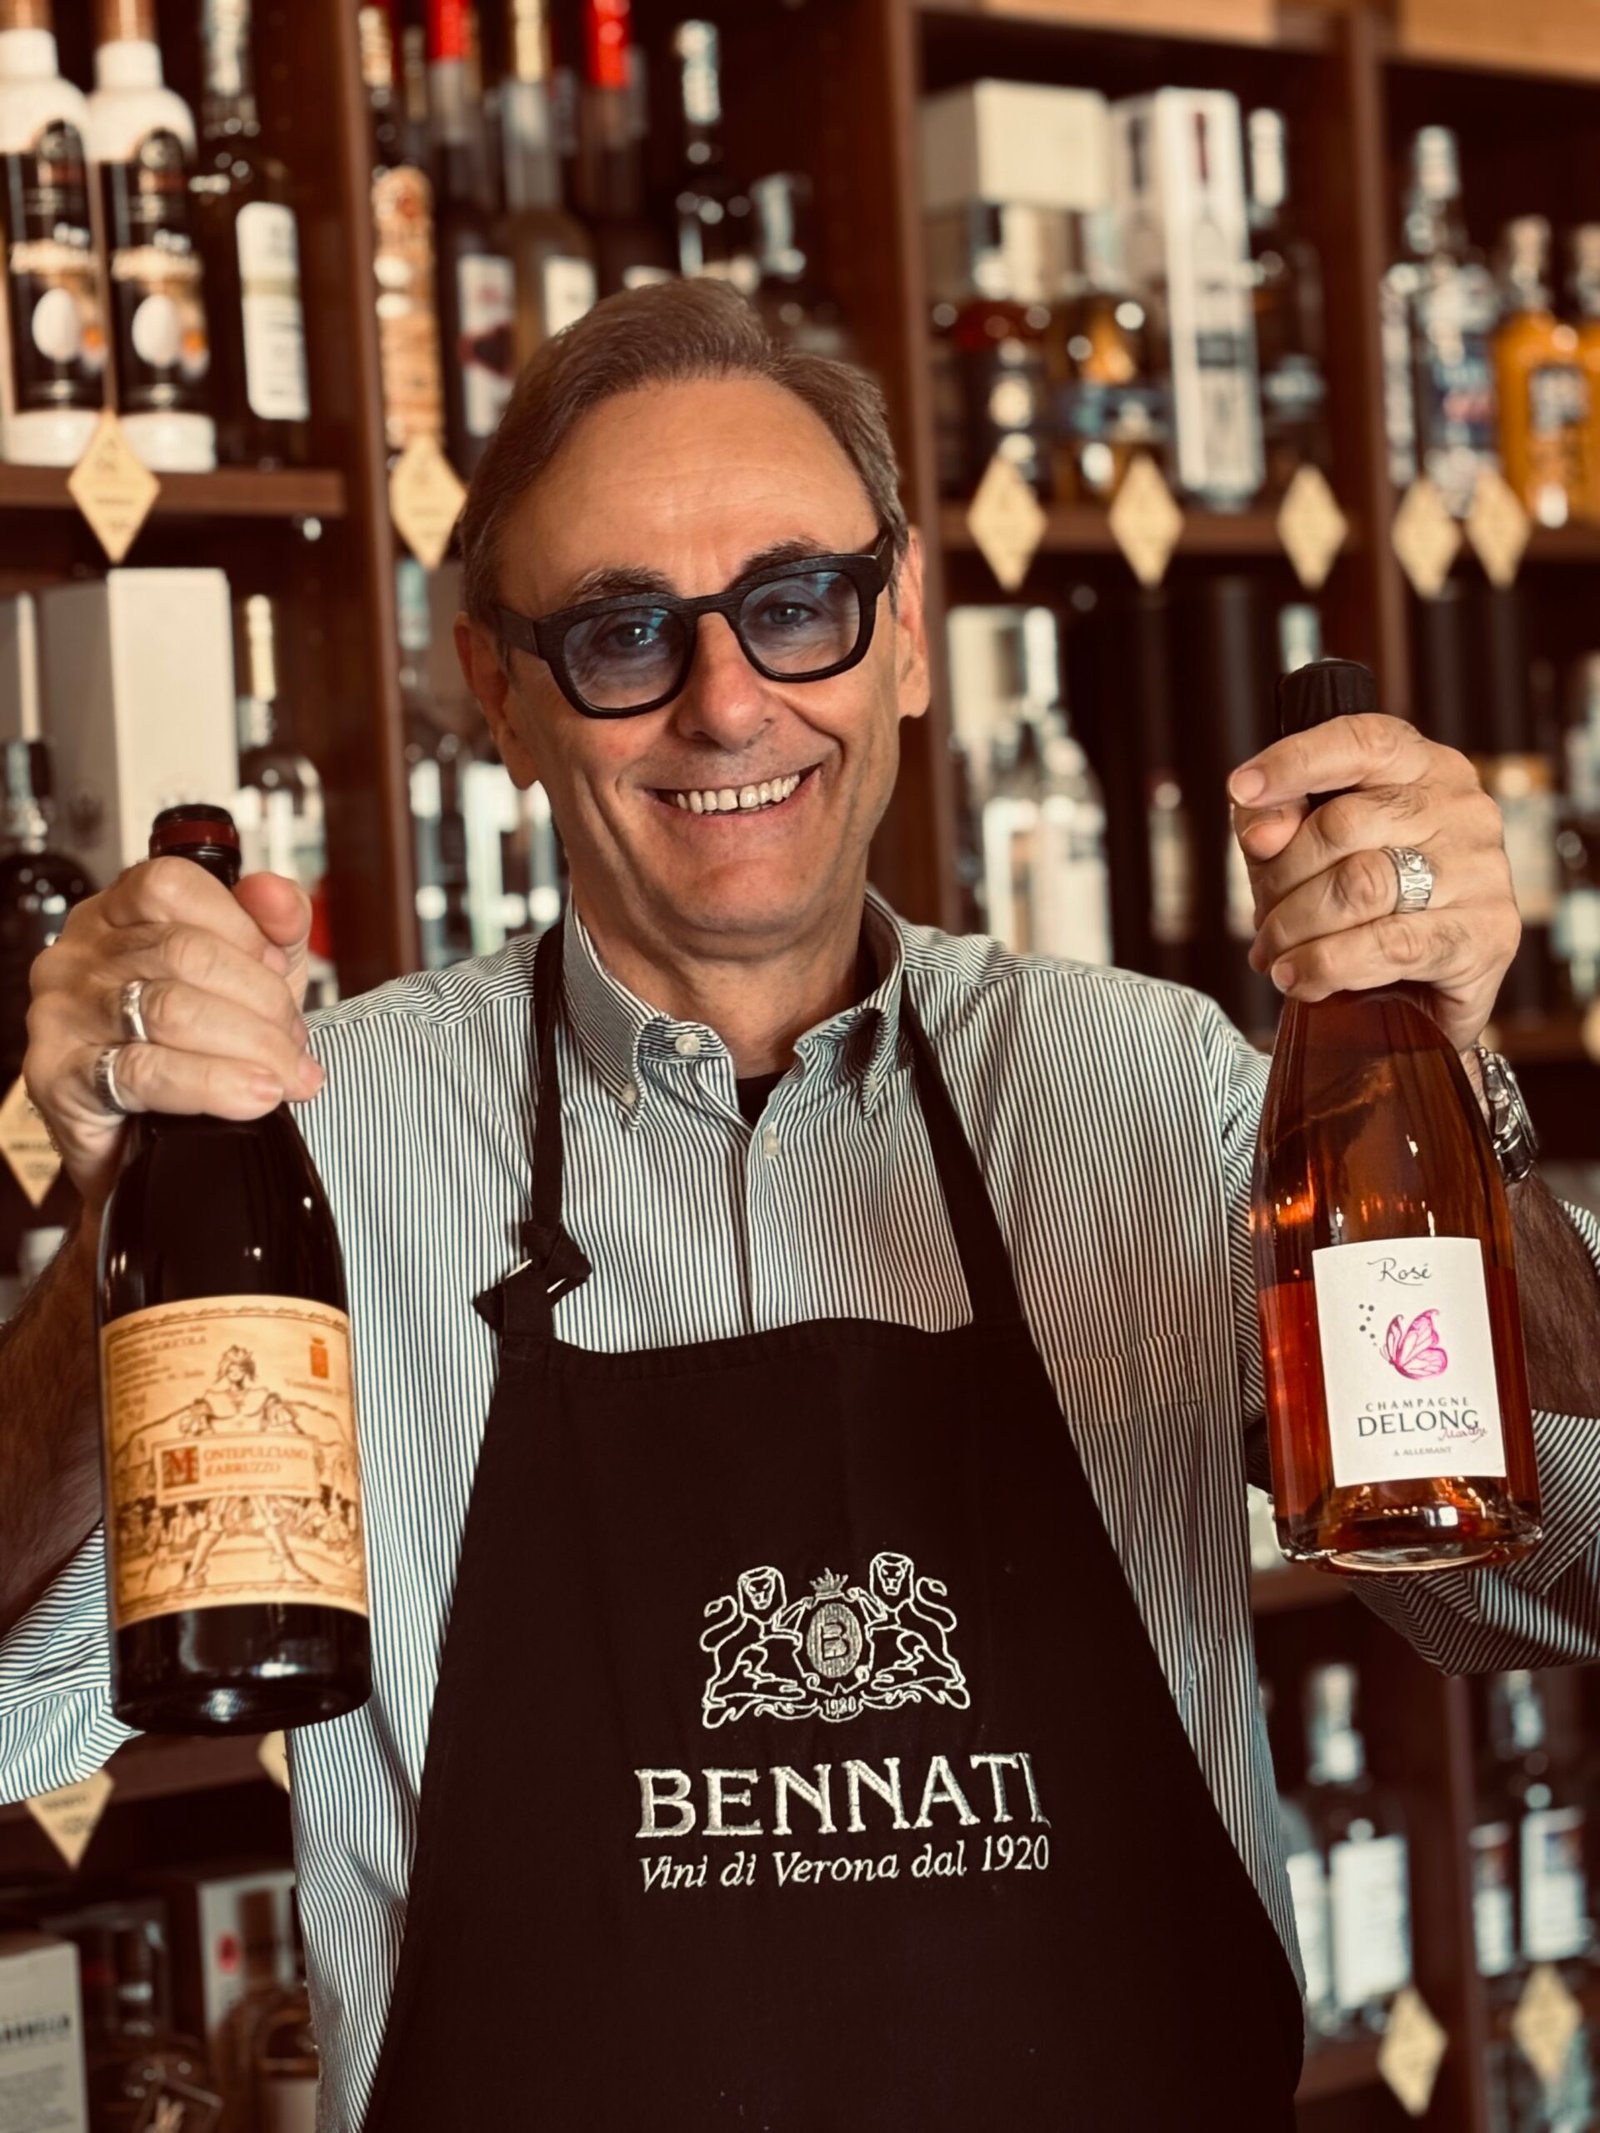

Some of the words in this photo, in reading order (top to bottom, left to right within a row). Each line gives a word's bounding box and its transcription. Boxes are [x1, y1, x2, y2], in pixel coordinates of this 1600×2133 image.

[1366, 1257, 1432, 1286] Rosé
[1365, 1397, 1470, 1413] CHAMPAGNE
[1357, 1409, 1479, 1437] DELONG
[820, 1622, 850, 1662] B
[824, 1696, 857, 1717] 1920
[634, 1752, 1051, 1838] BENNATI
[640, 1855, 708, 1893] Vini
[719, 1851, 756, 1886] di
[772, 1850, 900, 1887] Verona
[911, 1840, 967, 1878] dal
[980, 1834, 1049, 1873] 1920
